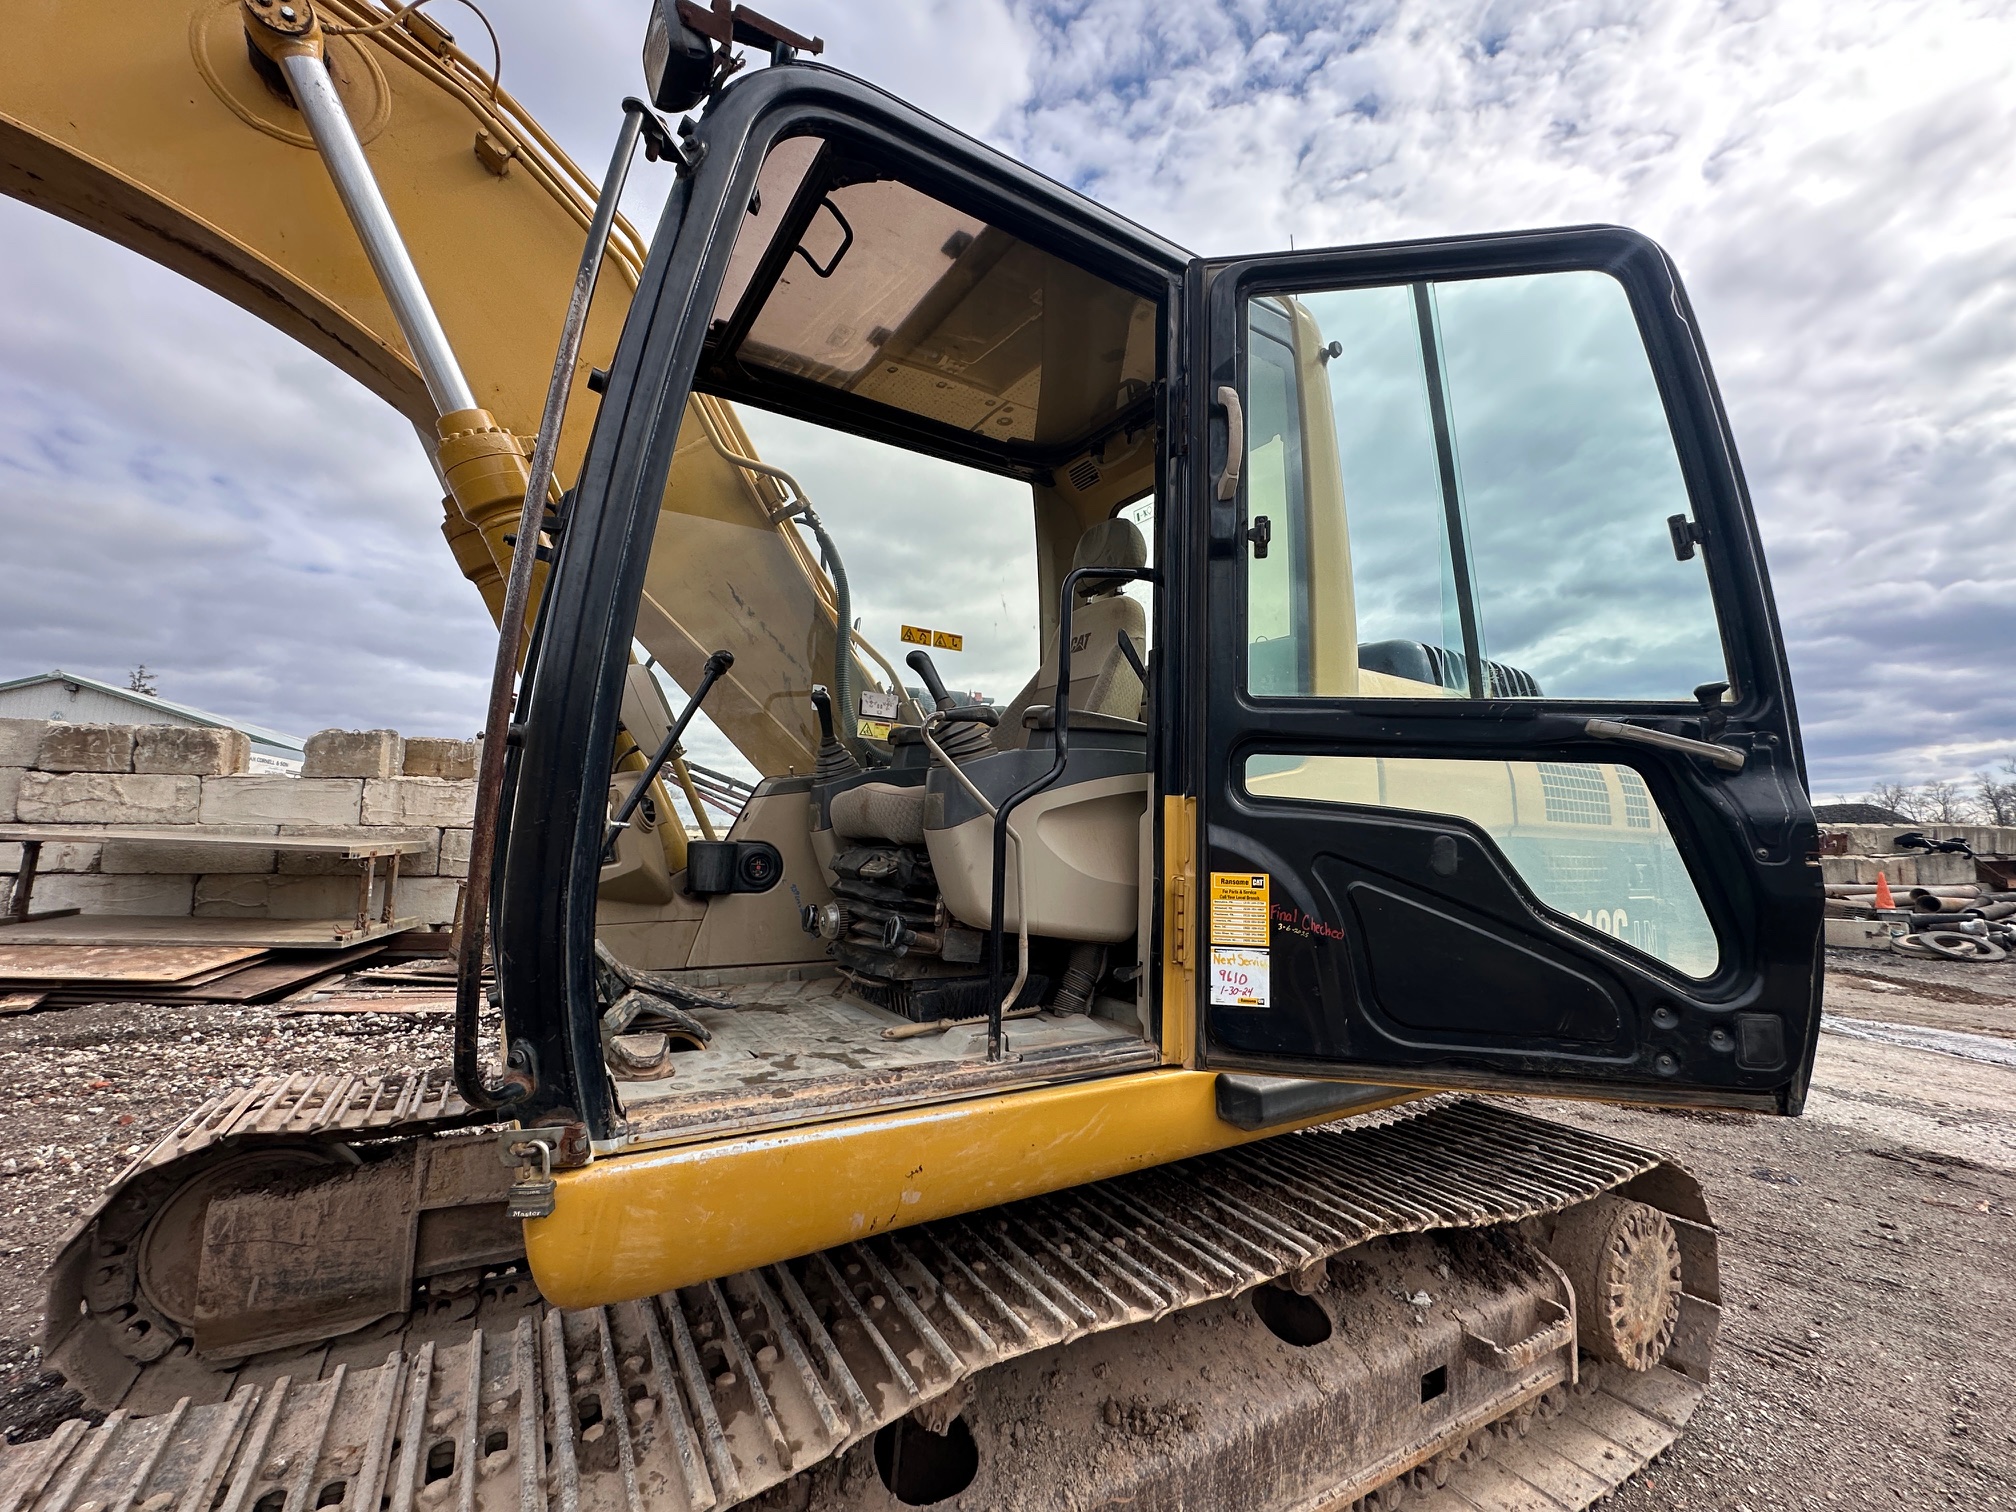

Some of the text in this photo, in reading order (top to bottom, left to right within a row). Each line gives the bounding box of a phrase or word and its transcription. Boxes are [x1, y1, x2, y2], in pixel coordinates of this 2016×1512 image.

[1071, 632, 1092, 653] CAT
[257, 757, 275, 765] CORNELL
[1220, 877, 1264, 887] Ransome CAT
[1270, 904, 1298, 922] Final
[1213, 953, 1236, 965] Next
[1219, 969, 1248, 985] 9610
[1220, 986, 1254, 998] 1-30-24
